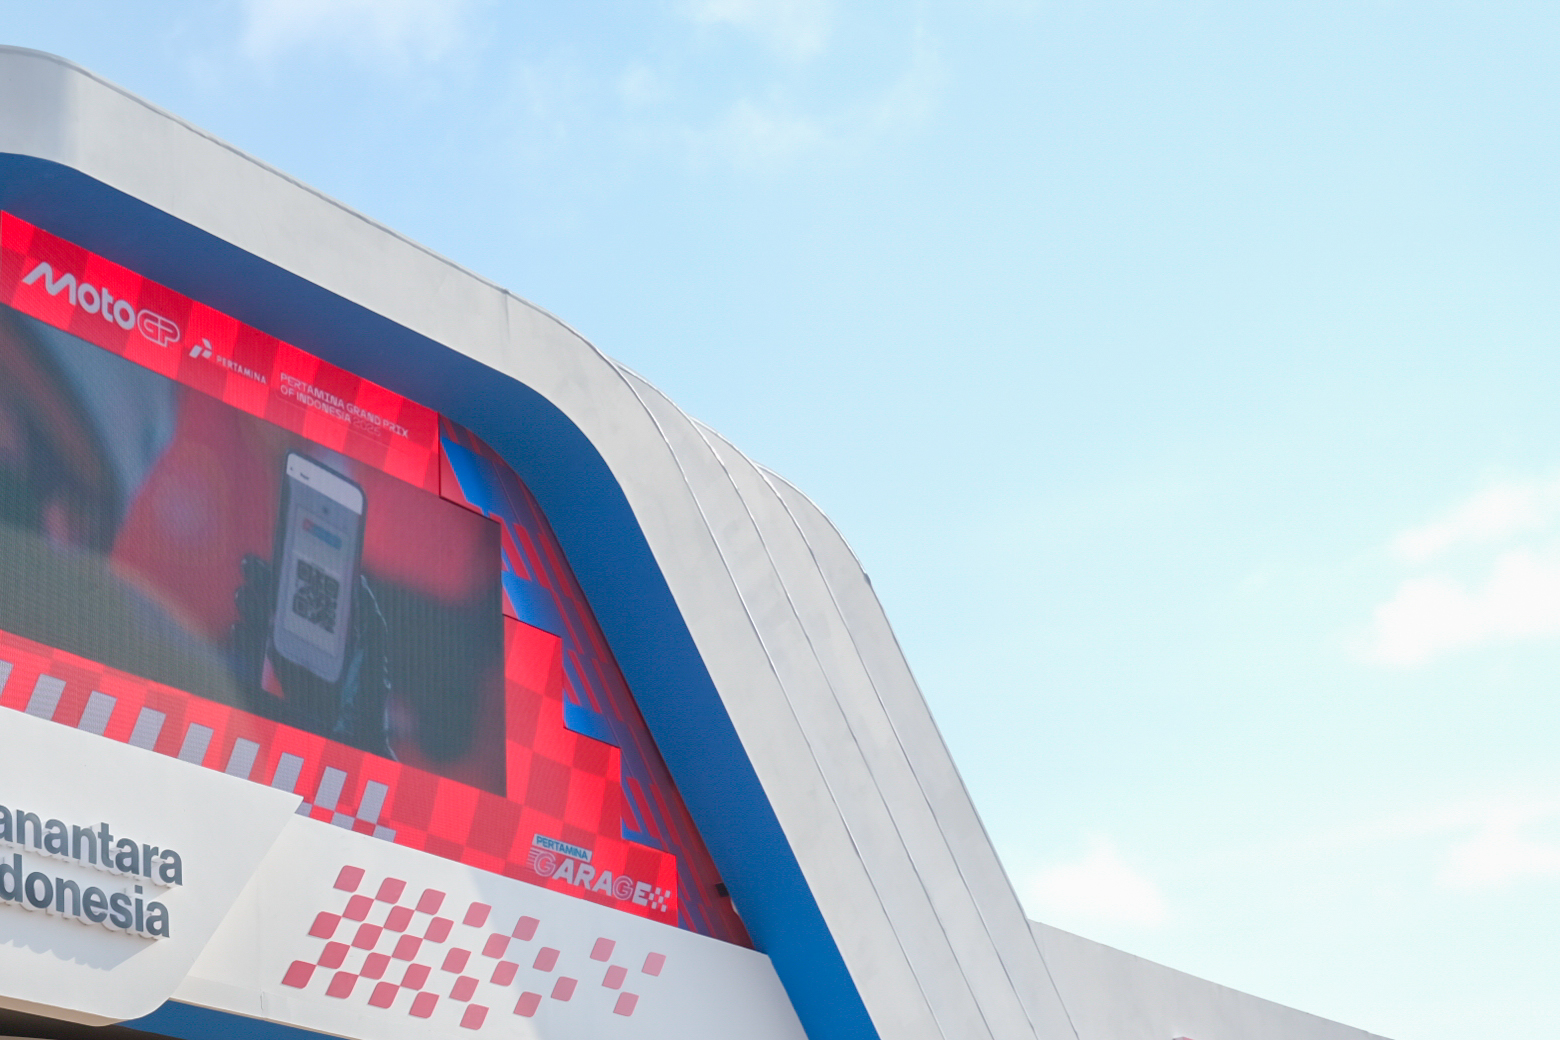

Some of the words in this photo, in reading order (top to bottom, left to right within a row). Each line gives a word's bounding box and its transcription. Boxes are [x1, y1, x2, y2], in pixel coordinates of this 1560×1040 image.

[22, 261, 180, 348] MotoGP
[216, 355, 267, 384] PERTAMINA
[280, 372, 345, 409] PERTAMINA
[345, 401, 381, 427] GRAND
[382, 419, 409, 438] PRIX
[280, 384, 294, 396] OF
[296, 391, 352, 423] INDONESIA
[352, 416, 382, 437] 2025
[536, 835, 589, 860] PERTAMINA
[529, 848, 652, 907] GARAGE
